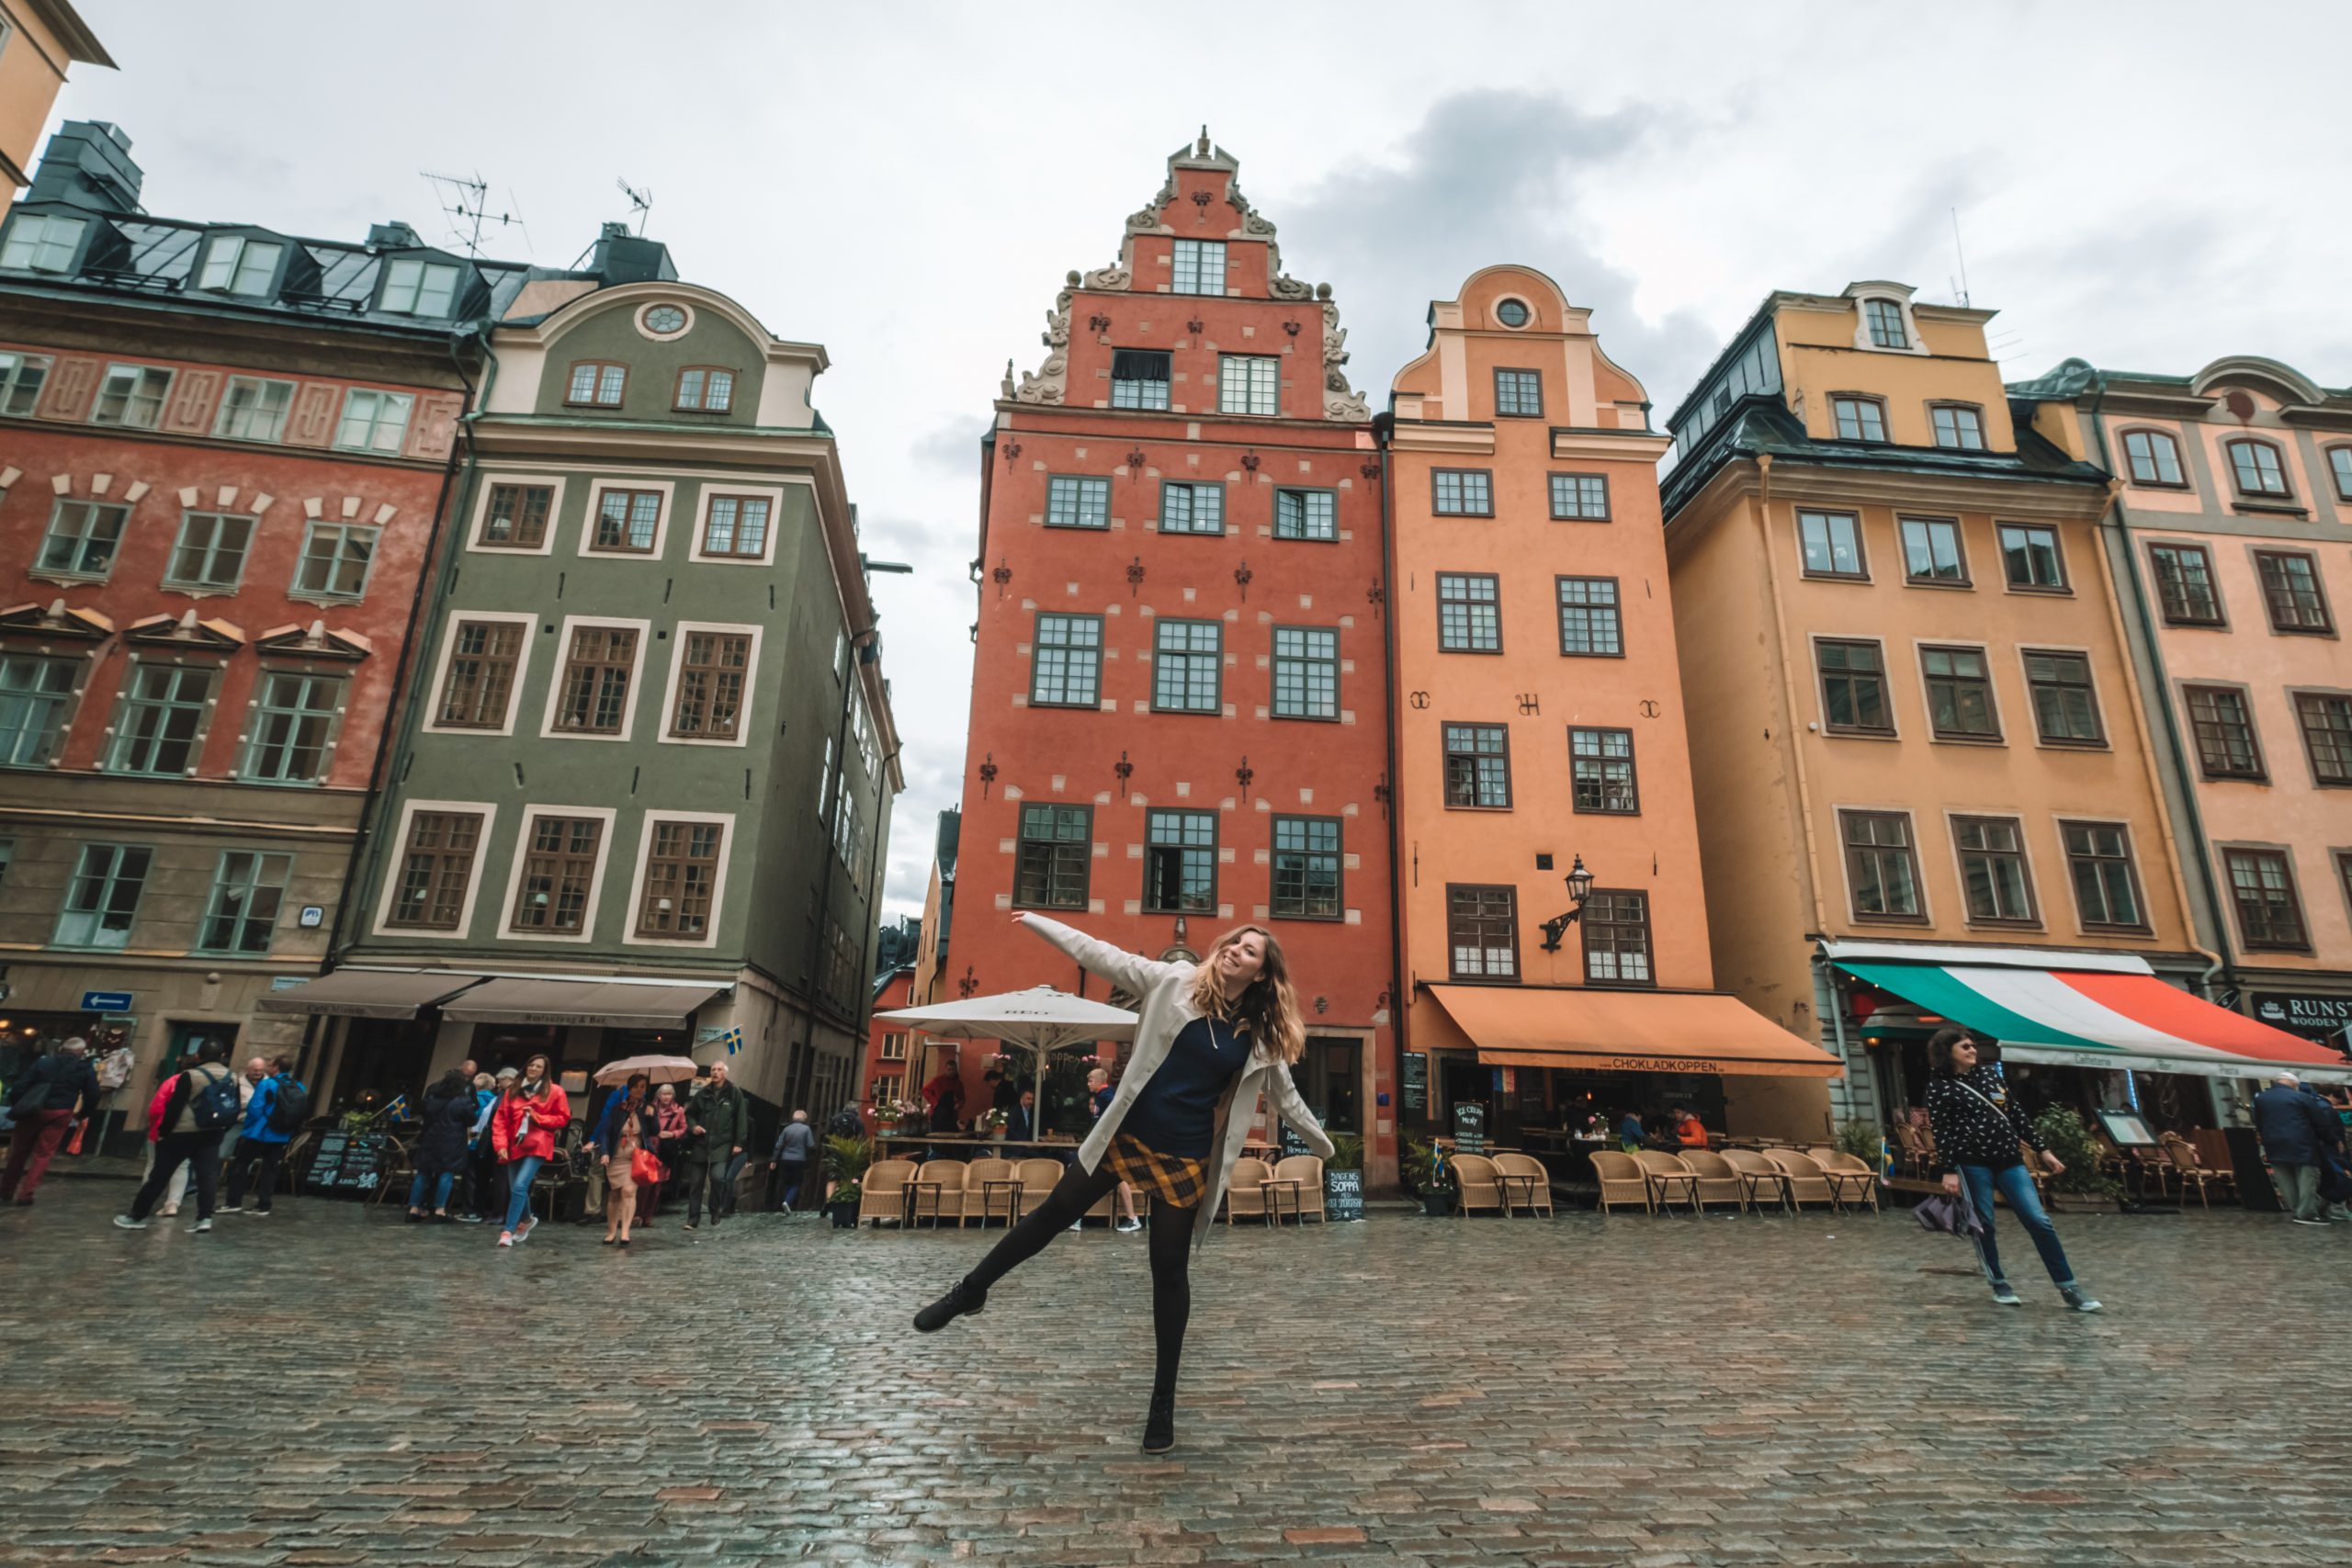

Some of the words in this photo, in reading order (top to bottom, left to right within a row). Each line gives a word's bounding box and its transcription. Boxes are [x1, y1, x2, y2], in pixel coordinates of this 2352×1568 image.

[526, 1013, 576, 1024] Restaurang
[579, 1015, 586, 1023] &
[2290, 1017, 2339, 1027] WOODEN
[1330, 1172, 1359, 1182] DAGENS
[1330, 1181, 1359, 1192] SOPPA
